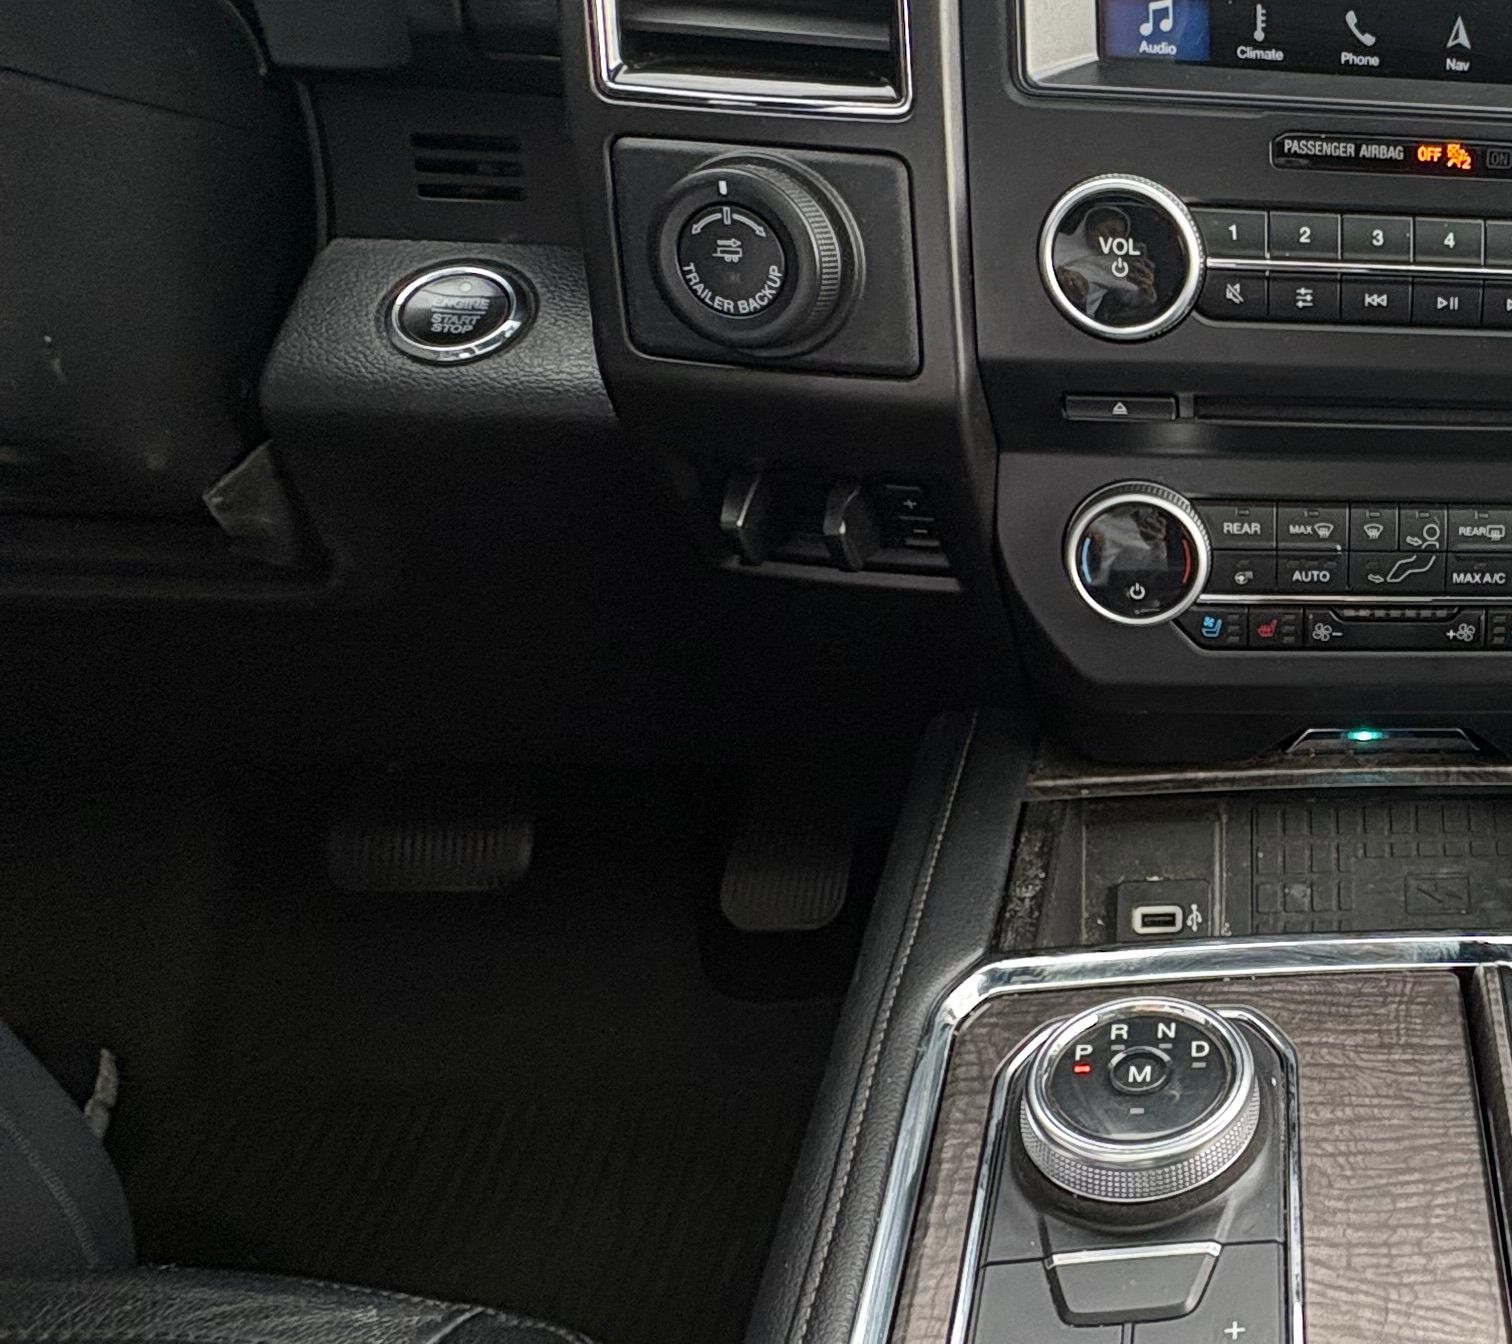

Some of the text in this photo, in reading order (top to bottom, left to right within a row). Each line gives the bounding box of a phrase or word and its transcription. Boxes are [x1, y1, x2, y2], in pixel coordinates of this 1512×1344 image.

[1139, 40, 1177, 56] Audio
[1236, 46, 1284, 62] Climate
[1340, 52, 1380, 67] Phone
[1446, 58, 1470, 72] Nav
[1284, 139, 1355, 158] PASSENGER
[1359, 143, 1405, 160] AIRBAG
[1417, 145, 1443, 162] OFF
[1490, 152, 1508, 165] ON
[1228, 224, 1238, 241] 1
[1299, 226, 1311, 243] 2
[1372, 229, 1384, 246] 3
[1444, 232, 1456, 249] 4
[1099, 237, 1141, 256] VOL
[683, 262, 785, 314] TRAILER BACKUP
[432, 297, 490, 310] ENGINE
[431, 313, 481, 325] START
[431, 323, 473, 333] STOP
[1223, 522, 1261, 534] REAR
[1289, 524, 1313, 534] MAX
[1458, 526, 1486, 537] REAR
[1292, 570, 1330, 583] AUTO
[1452, 572, 1506, 585] MAX A/C
[1110, 1024, 1128, 1041] R
[1157, 1022, 1176, 1039] N
[1075, 1044, 1094, 1062] P
[1191, 1041, 1210, 1058] D
[1128, 1065, 1152, 1083] M
